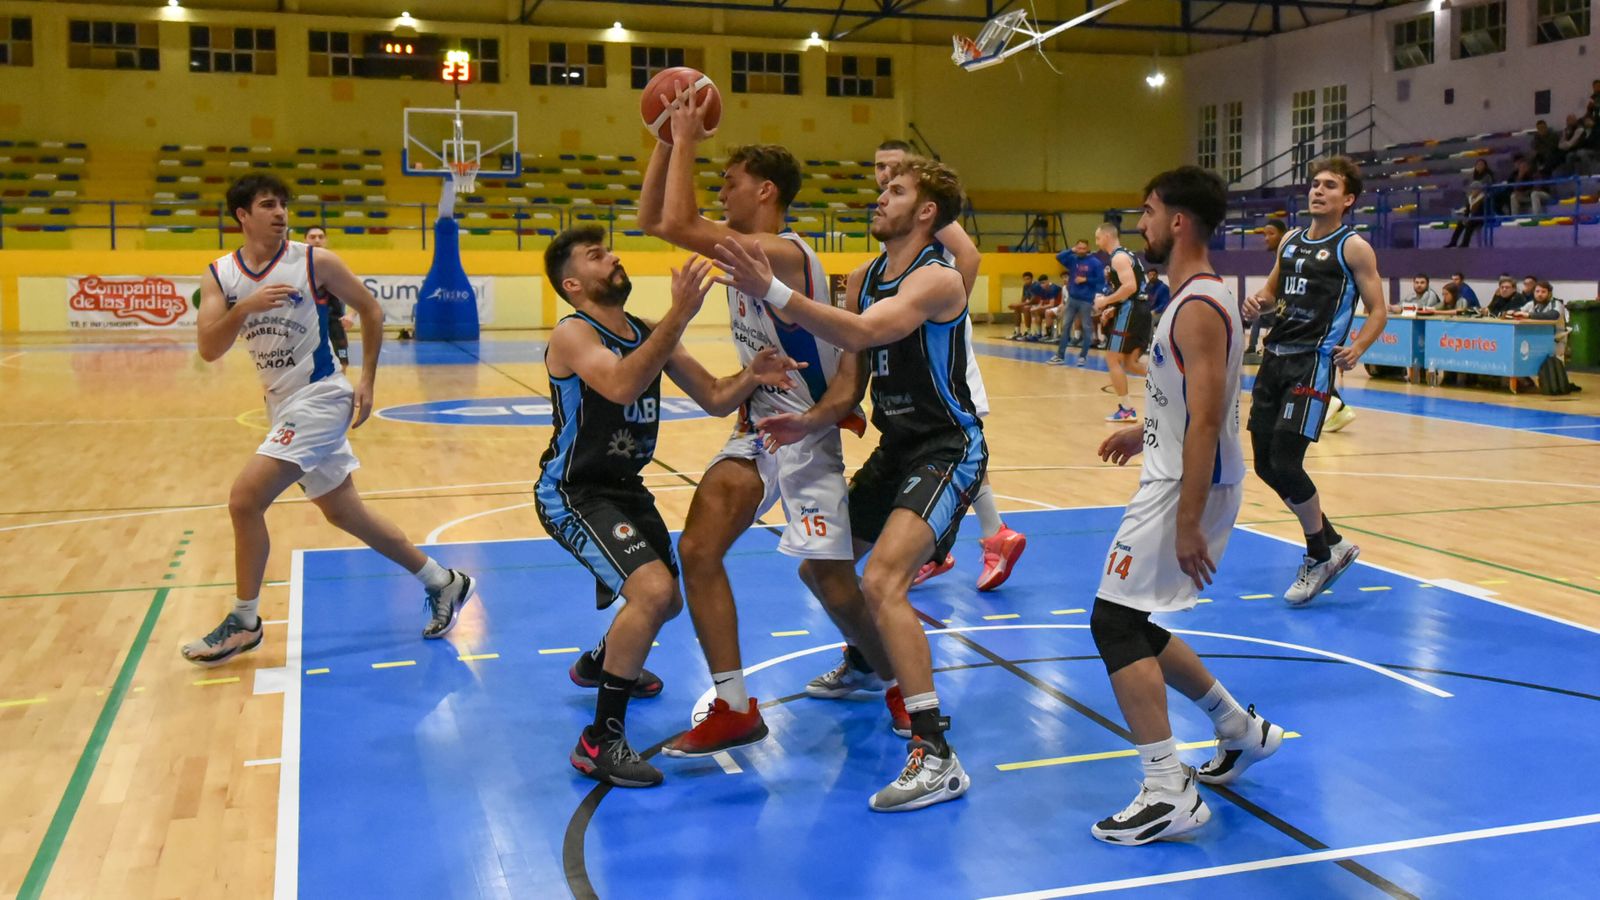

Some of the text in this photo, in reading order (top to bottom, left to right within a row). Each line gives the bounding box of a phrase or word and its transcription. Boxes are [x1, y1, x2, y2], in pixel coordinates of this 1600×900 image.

[442, 61, 470, 81] 23
[84, 277, 172, 295] Compañía
[363, 278, 425, 300] Sum
[1284, 276, 1308, 295] ULB
[72, 295, 95, 309] de
[100, 295, 125, 309] las
[1440, 332, 1497, 352] deportes
[271, 428, 296, 446] 28
[903, 476, 922, 494] 7
[801, 515, 827, 537] 15
[624, 540, 647, 555] vive
[1107, 551, 1133, 580] 14
